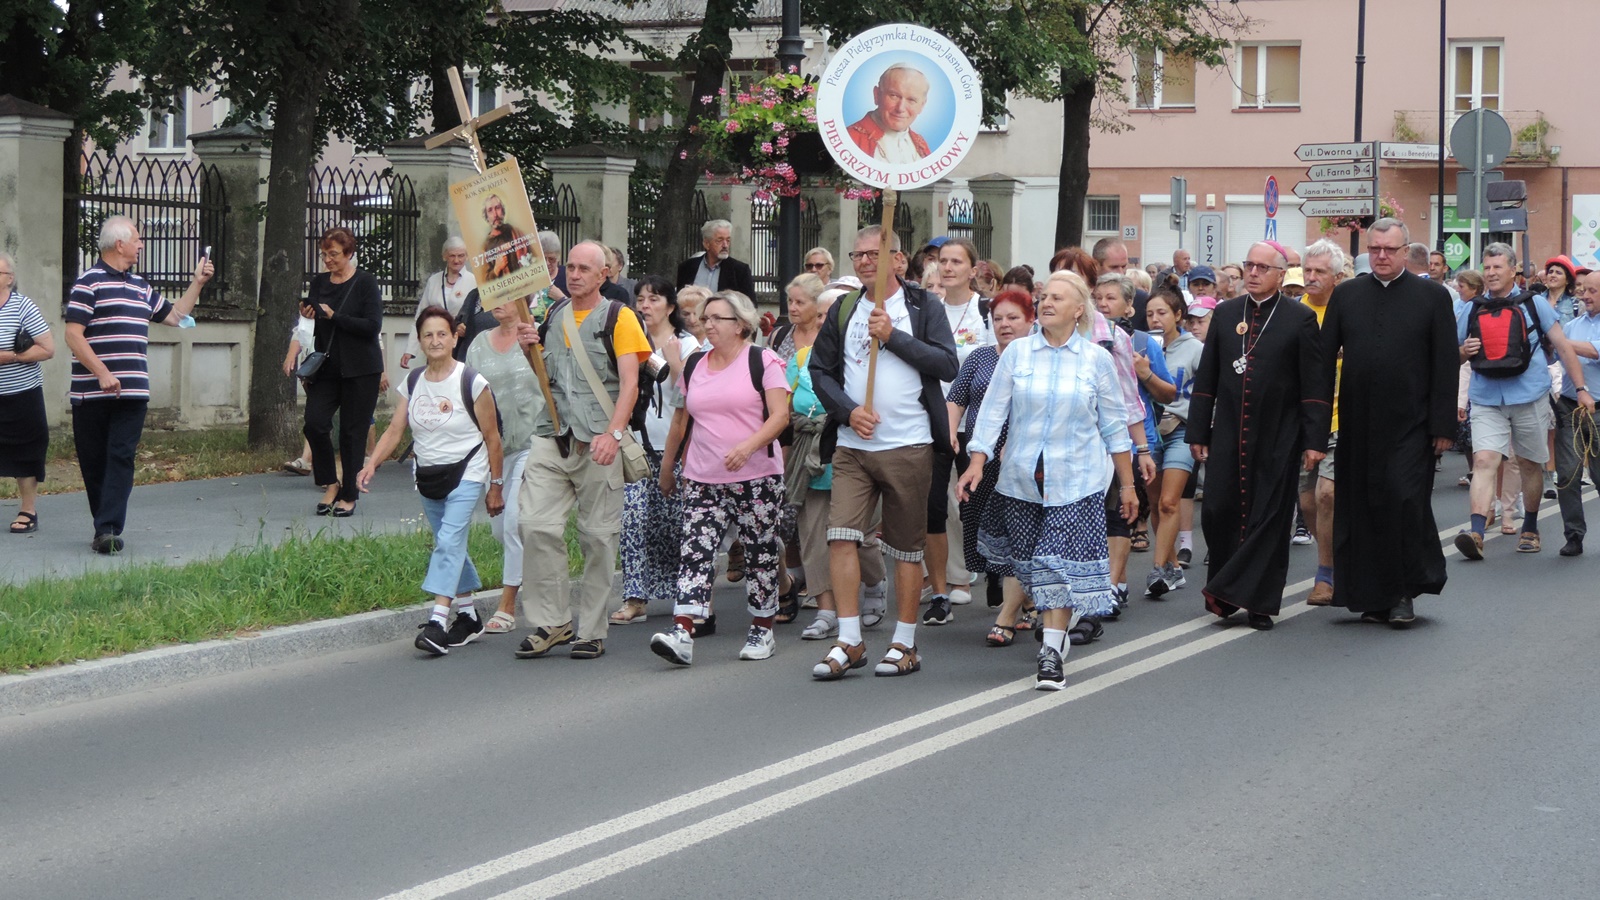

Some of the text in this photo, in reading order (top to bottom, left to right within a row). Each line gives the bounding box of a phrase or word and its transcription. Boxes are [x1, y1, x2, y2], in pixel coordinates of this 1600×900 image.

[826, 57, 850, 87] Piesza
[846, 26, 907, 59] Pielgrzymka
[960, 74, 973, 100] Góra
[823, 118, 970, 185] PIELGRZYM DUCHOWY
[1304, 148, 1352, 157] ul. Dworna
[1315, 168, 1351, 177] ul. Farna
[1311, 207, 1354, 215] Sienkiewicza
[1125, 227, 1135, 236] 33
[1445, 243, 1463, 255] 30
[472, 253, 484, 268] 37
[482, 285, 496, 296] 1-14
[496, 272, 530, 290] SIERPNIA
[530, 264, 545, 277] 2021
